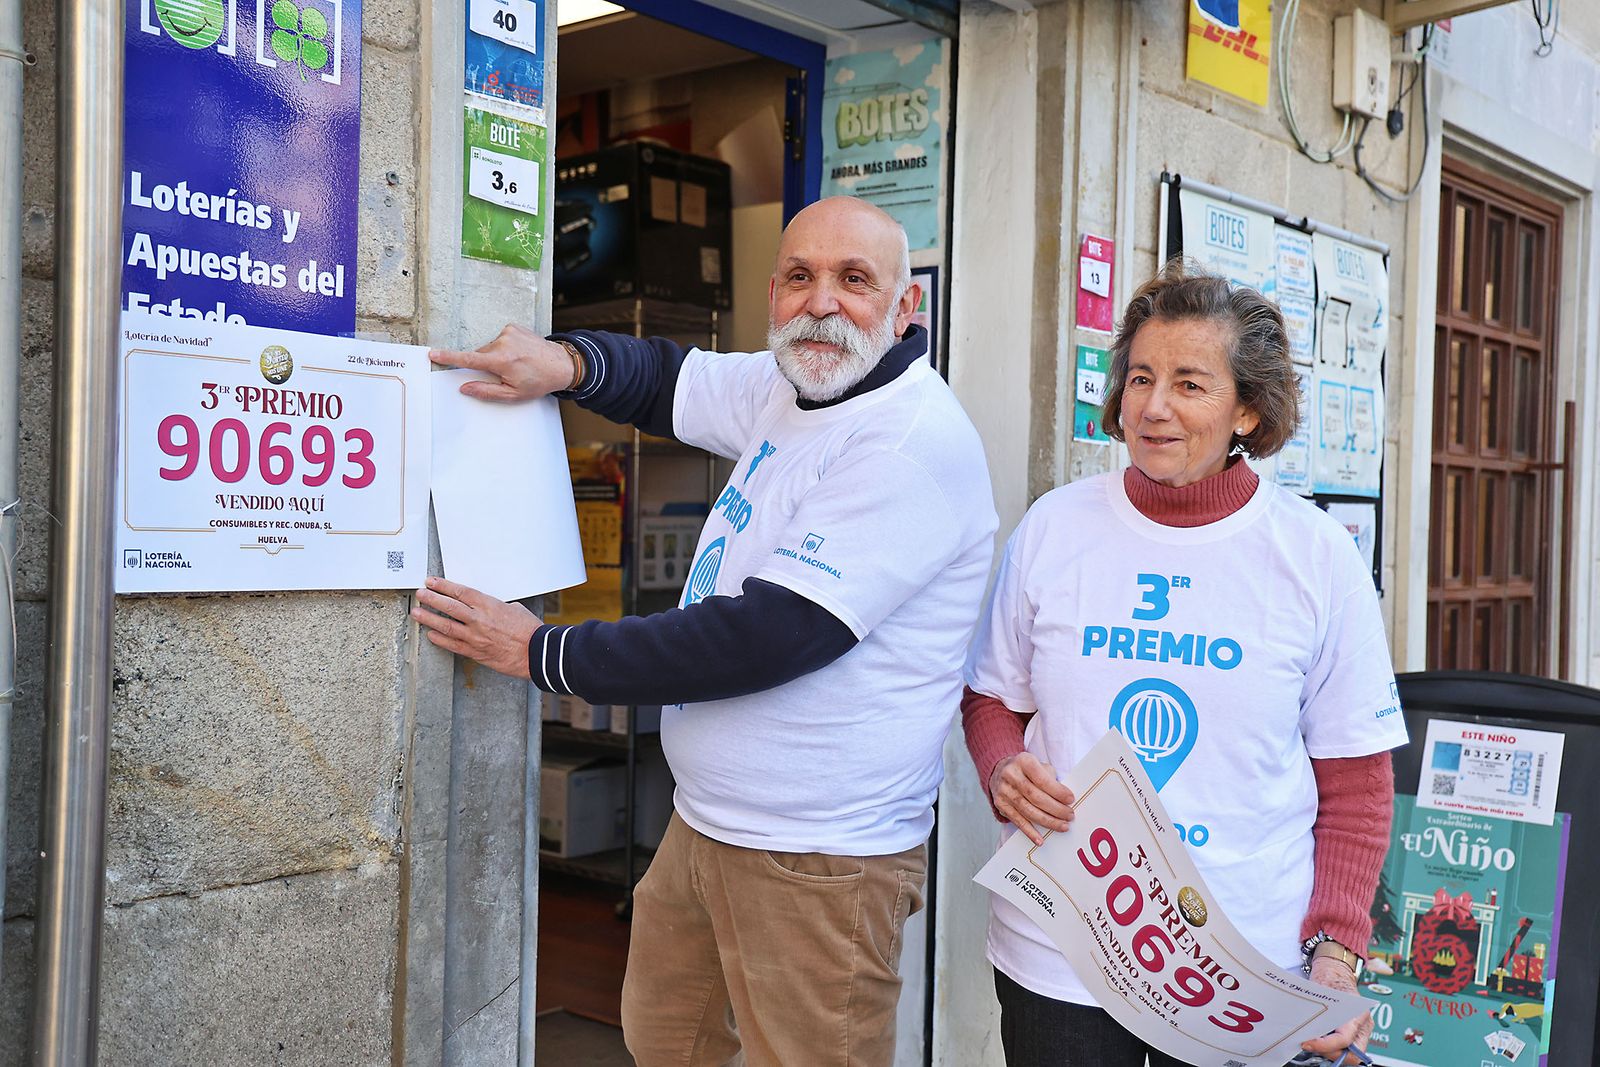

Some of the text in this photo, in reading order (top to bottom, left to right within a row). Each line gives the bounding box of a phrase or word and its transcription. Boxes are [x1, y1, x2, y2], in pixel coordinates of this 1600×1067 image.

[492, 10, 517, 32] 40
[836, 88, 929, 147] BOTES
[490, 122, 520, 148] BOTE
[863, 161, 883, 175] MÁS
[885, 156, 928, 173] GRANDES
[492, 170, 518, 194] 3,6
[130, 171, 301, 244] Loterías y
[1210, 210, 1244, 250] BOTES
[127, 232, 345, 298] Apuestas del
[1091, 272, 1100, 285] 13
[1336, 248, 1365, 280] BOTES
[160, 334, 172, 344] de
[173, 335, 212, 347] Navidad
[348, 354, 406, 369] 22 de Diciembre
[235, 385, 343, 420] PREMIO
[157, 414, 376, 488] 90693
[215, 494, 325, 515] VENDIDO AQUÍ
[209, 520, 332, 530] CONSUMIBLES Y REC. ONUBA, SL
[258, 536, 288, 544] HUELVA
[145, 552, 183, 560] LOTERÍA
[145, 560, 192, 569] NACIONAL
[798, 554, 842, 580] NACIONAL
[1082, 625, 1243, 670] PREMIO
[1462, 730, 1517, 744] ESTE NIÑO
[1464, 748, 1512, 762] 83227
[1136, 786, 1144, 798] de
[1143, 797, 1166, 832] Navidad
[1400, 826, 1516, 872] El Niño
[1020, 884, 1056, 918] NACIONAL
[1025, 880, 1054, 908] LOTERÍA
[1076, 828, 1264, 1034] 90693
[1148, 876, 1240, 992] PREMIO
[1083, 912, 1118, 970] CONSUMIBLES
[1122, 977, 1138, 996] REC.
[1168, 1020, 1179, 1028] SL
[1095, 906, 1181, 1016] VENDIDO AQUÍ
[1103, 966, 1128, 997] HUELVA
[1265, 970, 1277, 980] 22
[1289, 984, 1340, 1002] Diciembre
[1406, 992, 1474, 1020] ENERO
